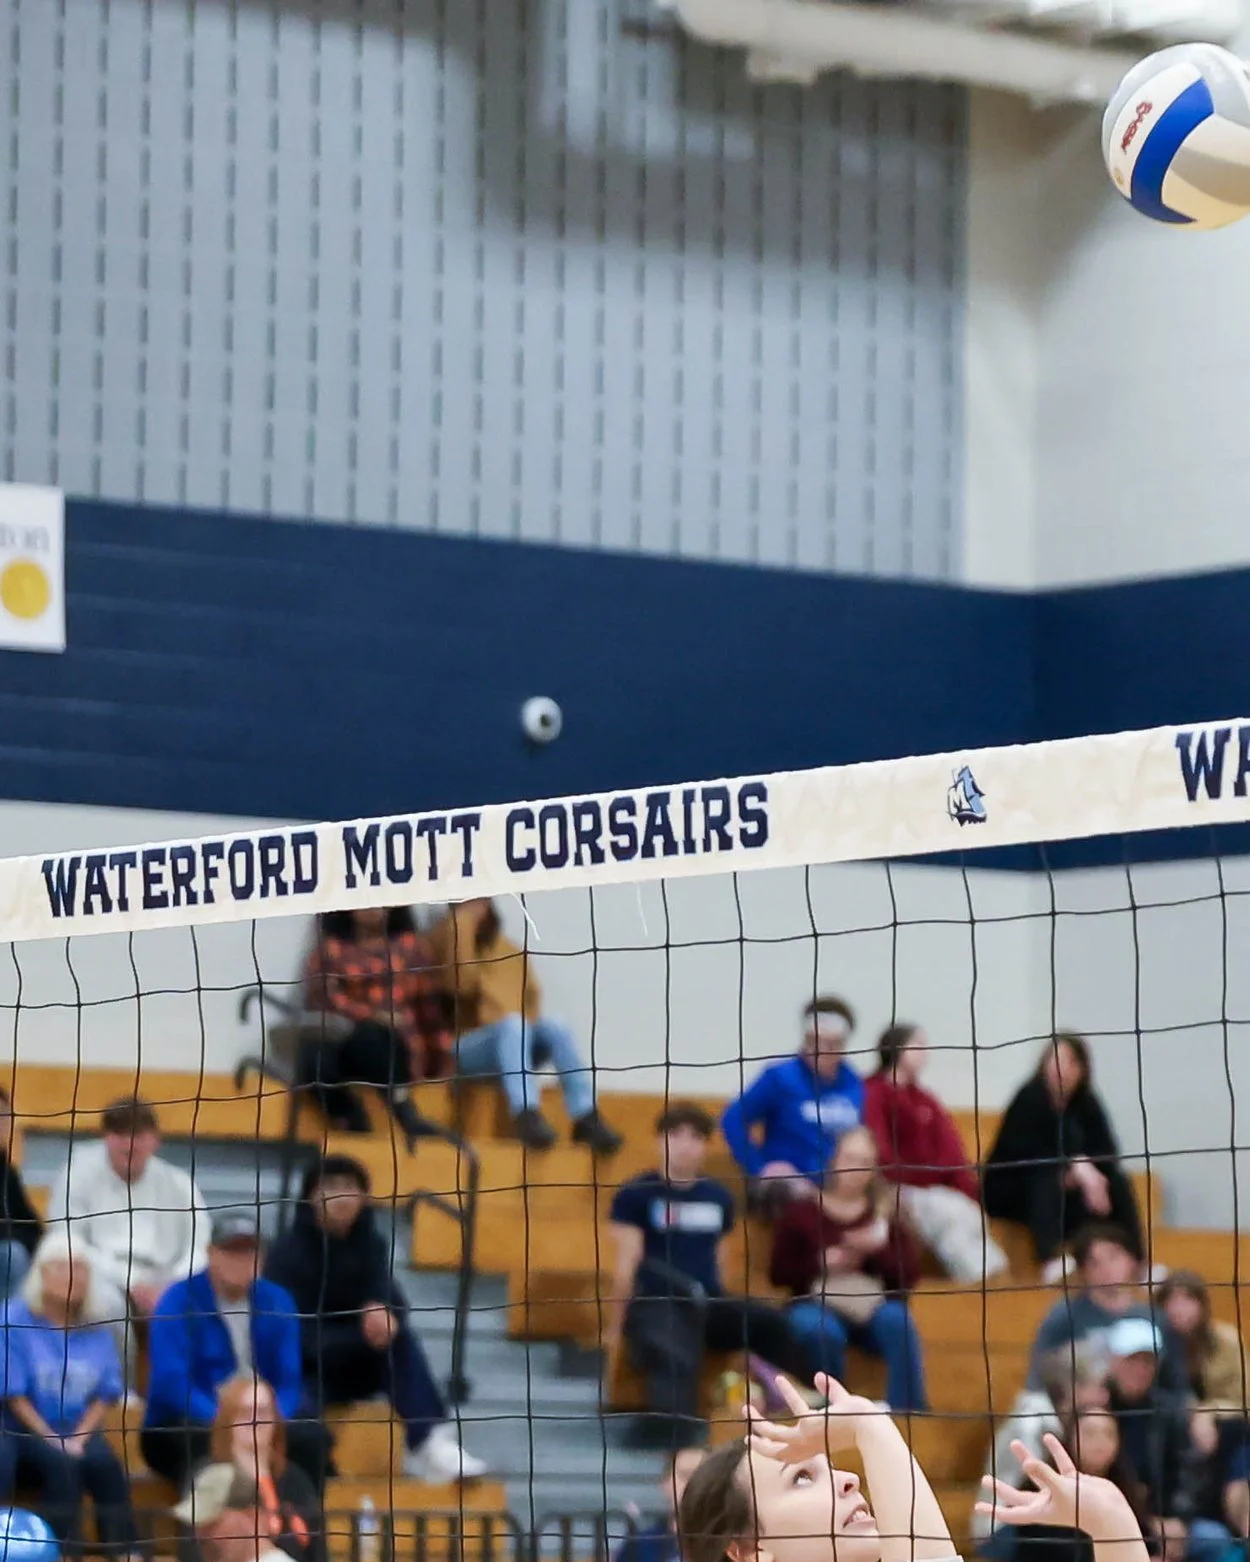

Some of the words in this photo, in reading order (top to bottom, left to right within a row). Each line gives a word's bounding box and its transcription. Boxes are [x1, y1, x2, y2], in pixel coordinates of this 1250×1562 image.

[42, 831, 318, 918] WATERFORD
[342, 813, 481, 889] MOTT
[505, 782, 769, 873] CORSAIRS
